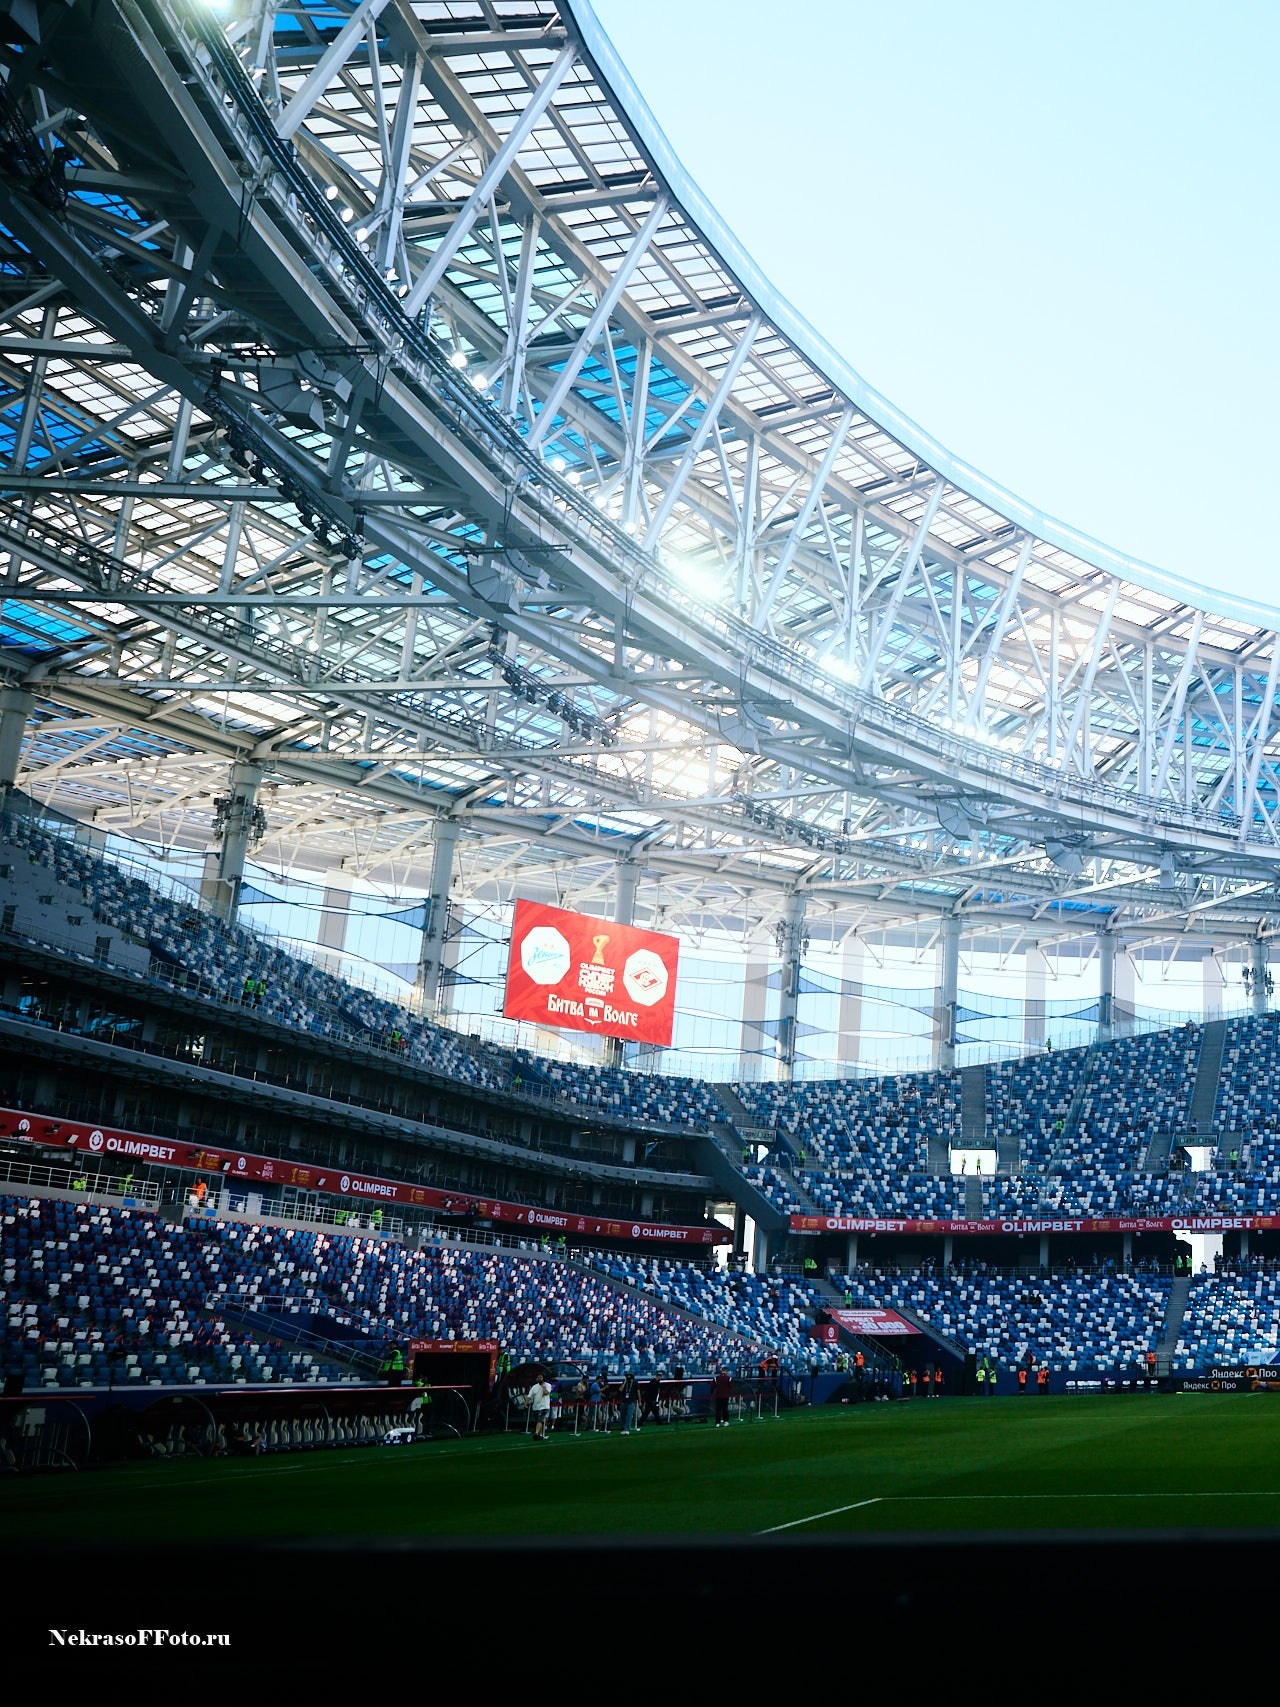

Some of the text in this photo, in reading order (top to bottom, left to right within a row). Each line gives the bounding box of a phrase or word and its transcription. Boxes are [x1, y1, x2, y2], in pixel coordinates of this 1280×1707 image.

[106, 1137, 176, 1160] OLIMPBET
[351, 1180, 398, 1197] OLIMPBET
[535, 1213, 568, 1227] OLIMPBET
[825, 1218, 907, 1232] OLIMPBET
[1170, 1217, 1254, 1229] OLIMPBET
[1001, 1221, 1084, 1232] OLIMPBET
[642, 1228, 688, 1239] OLIMPBET
[1211, 1368, 1245, 1379] Яндекс
[1182, 1381, 1237, 1390] Яндекс Про
